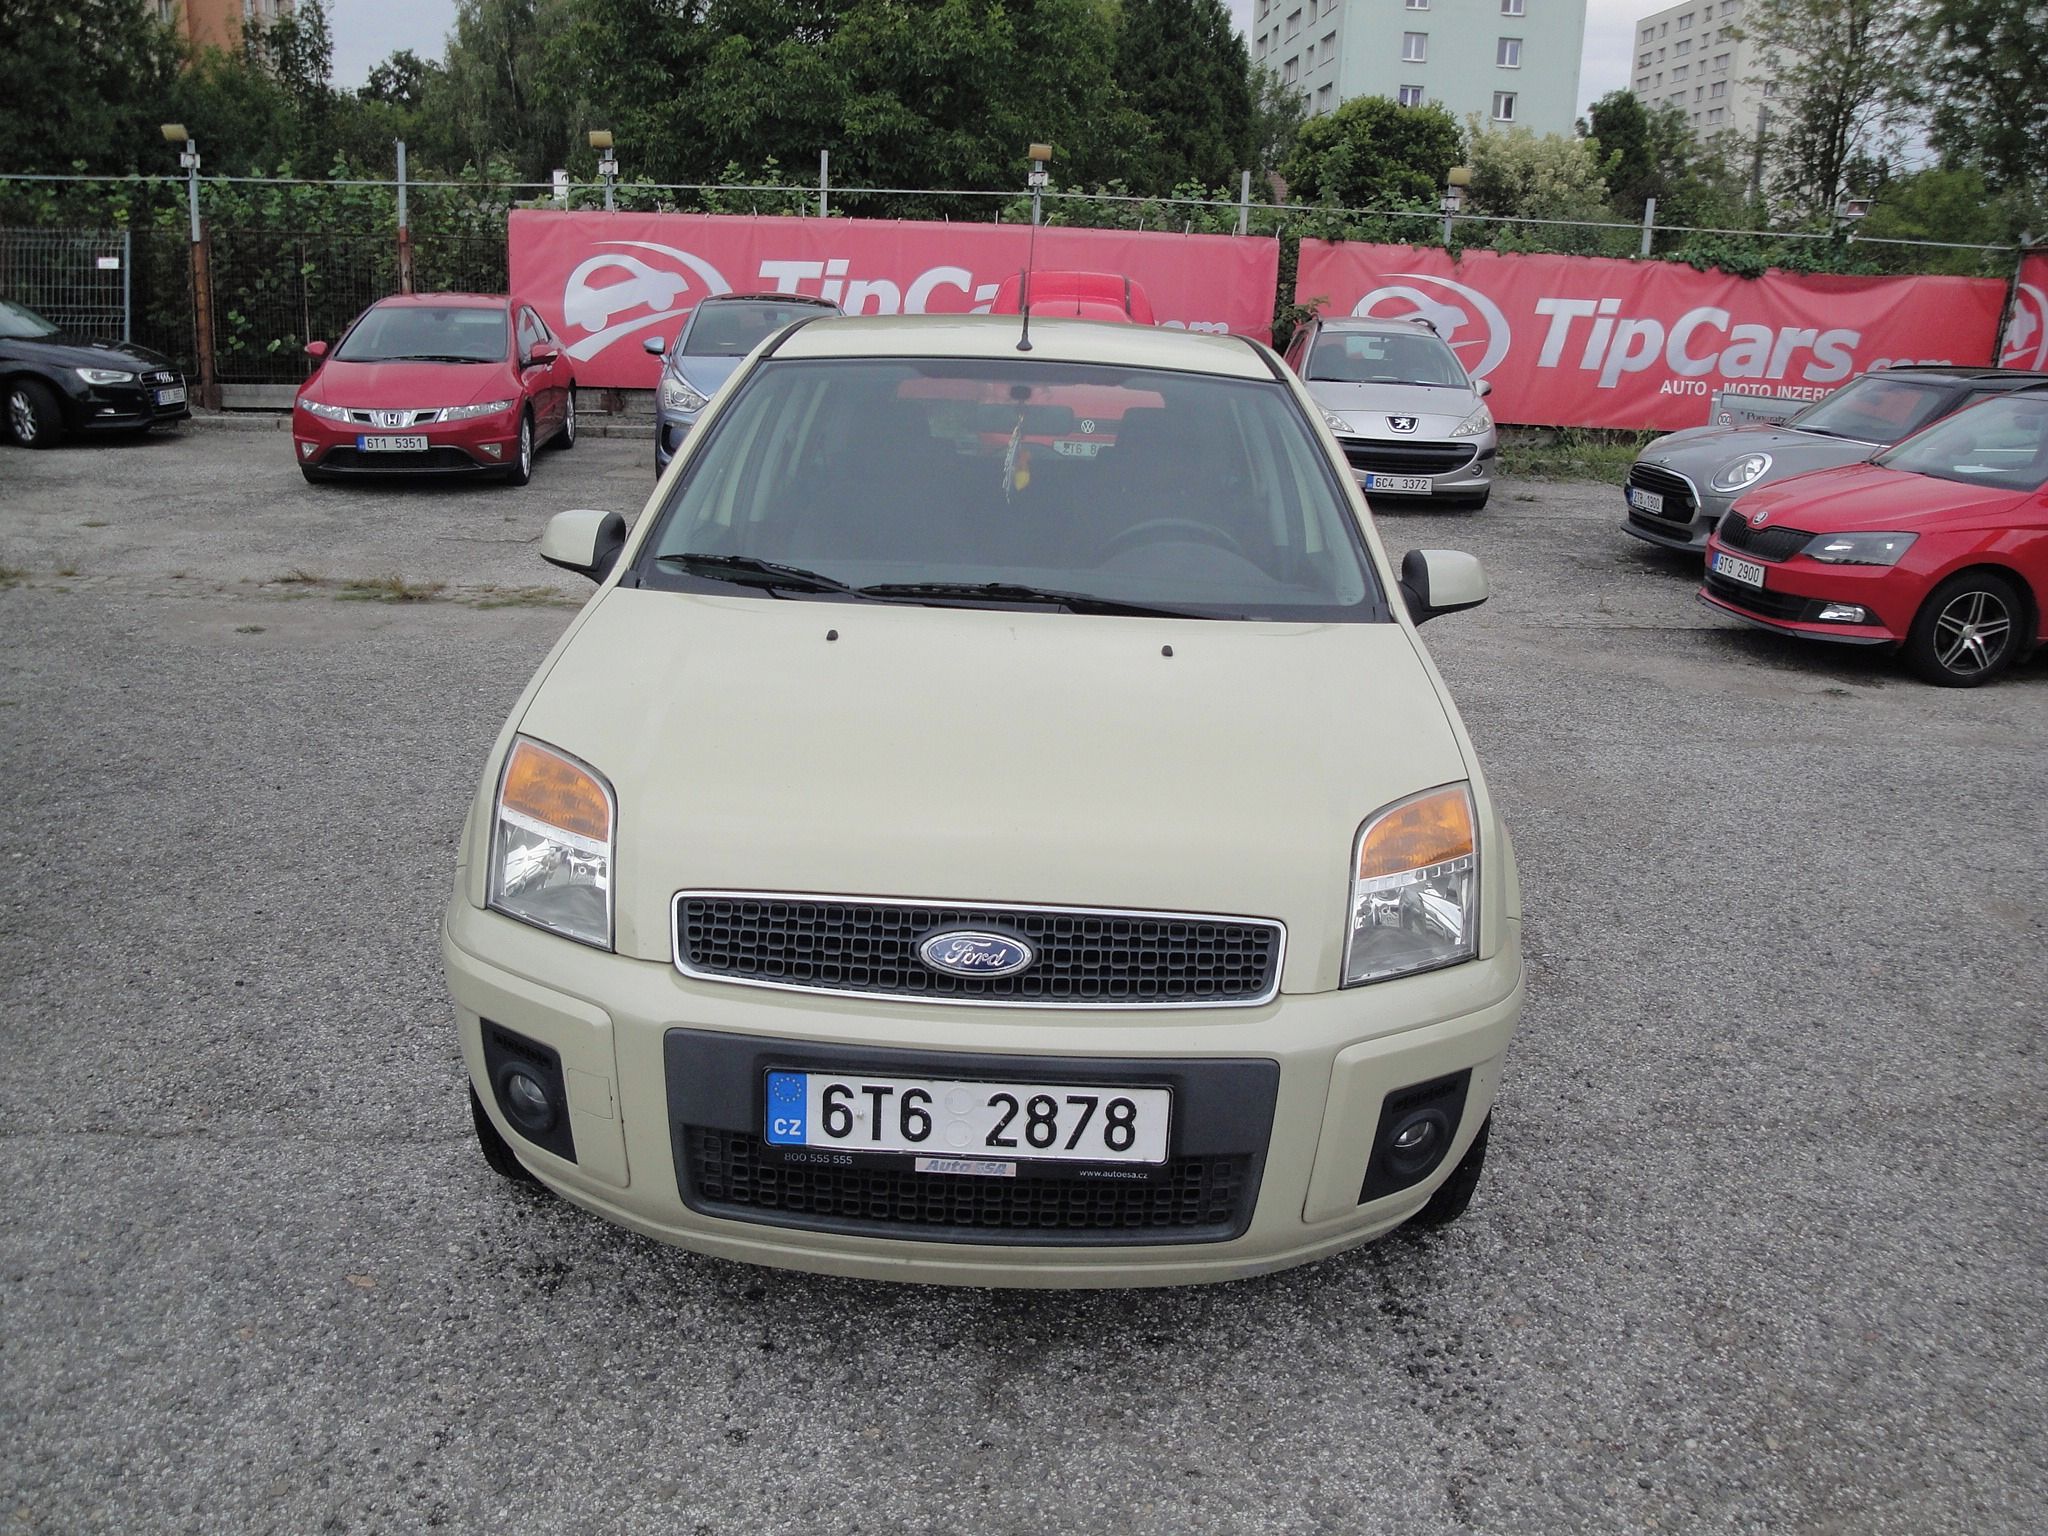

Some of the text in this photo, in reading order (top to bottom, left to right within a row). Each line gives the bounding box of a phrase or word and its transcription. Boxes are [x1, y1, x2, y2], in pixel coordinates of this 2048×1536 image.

[1660, 379, 1708, 396] AUTO
[1723, 382, 1772, 397] MOTO
[367, 437, 422, 449] 6T1 5351
[1375, 477, 1428, 490] 6C4 3372
[1718, 555, 1760, 583] 9T9 2900
[944, 939, 1007, 967] Ford
[821, 1083, 1137, 1152] 6T6 2878
[774, 1118, 802, 1136] CZ
[784, 1152, 853, 1165] 800 555 555
[1079, 1170, 1148, 1179] www.autoesa.cz
